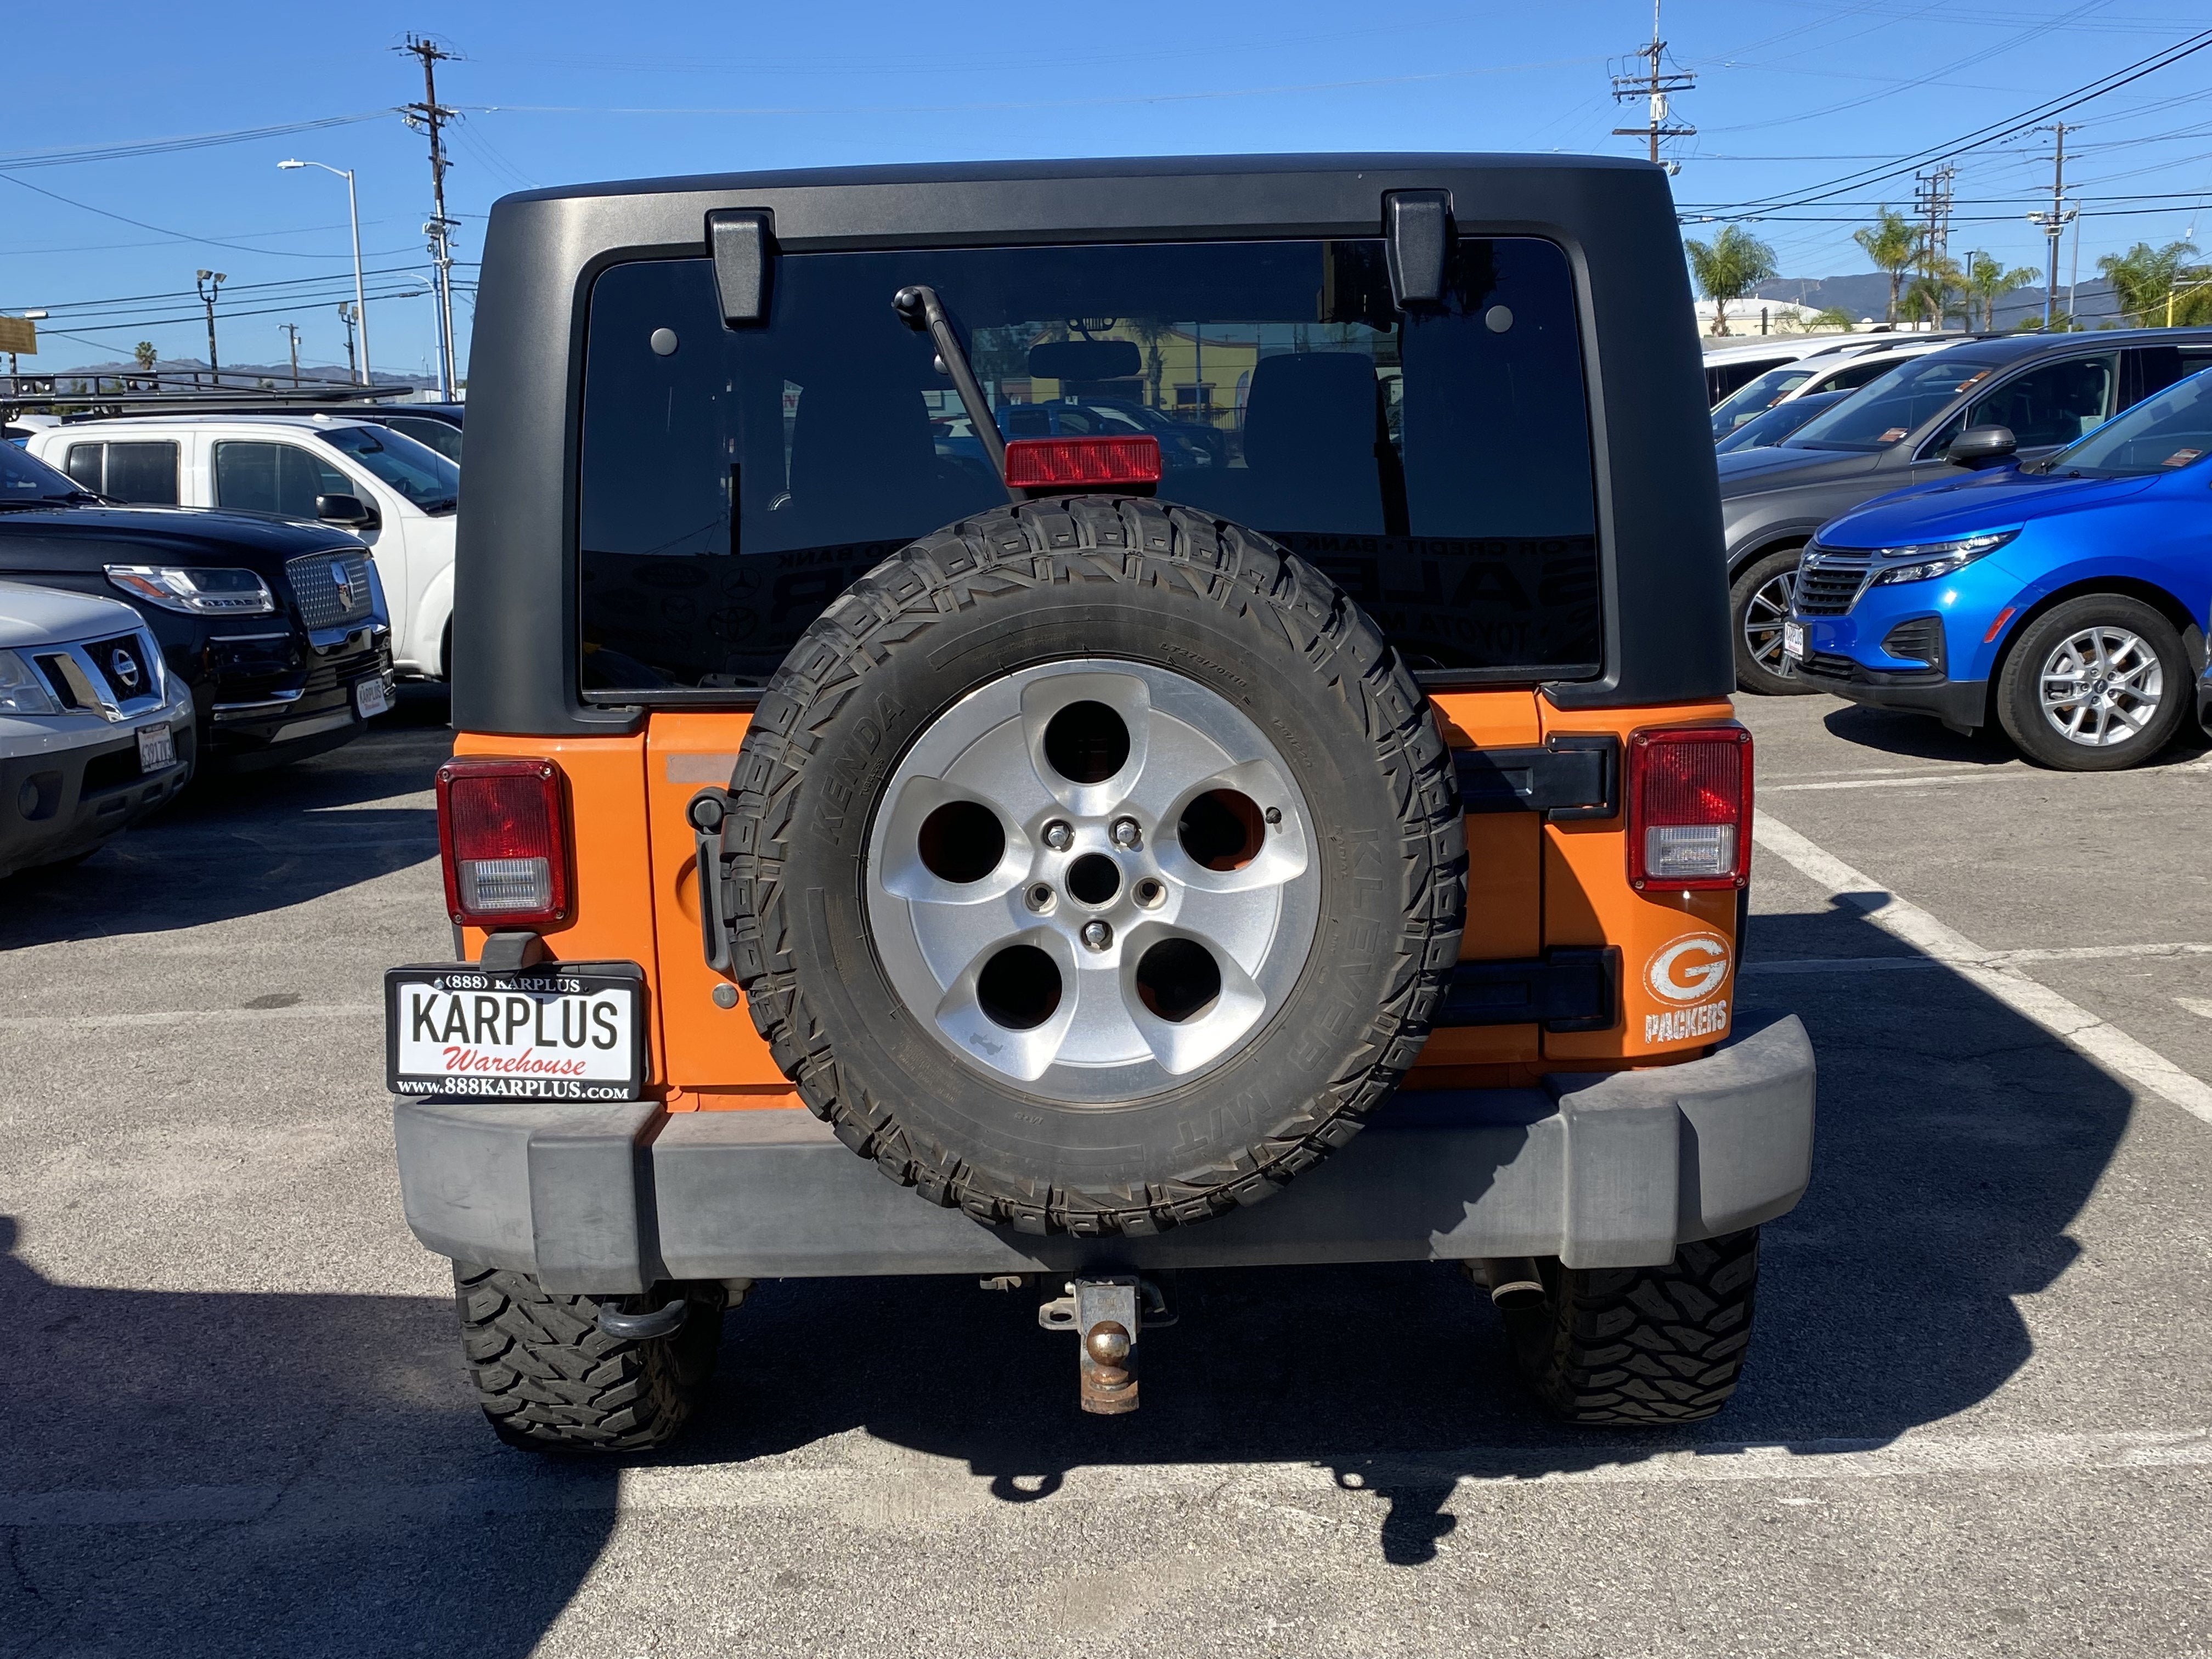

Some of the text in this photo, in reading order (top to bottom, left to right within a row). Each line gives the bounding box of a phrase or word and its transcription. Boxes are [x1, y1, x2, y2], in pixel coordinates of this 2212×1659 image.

[810, 692, 905, 847] KENDA
[860, 758, 884, 796] TUBELESS
[1287, 828, 1383, 1071] KLEVER
[1651, 939, 1726, 1000] G
[445, 975, 580, 992] (888) KARPLUS
[412, 993, 619, 1050] KARPLUS
[1645, 1000, 1726, 1043] PACKERS
[443, 1046, 586, 1076] Warehouse
[1173, 1084, 1272, 1155] M/T
